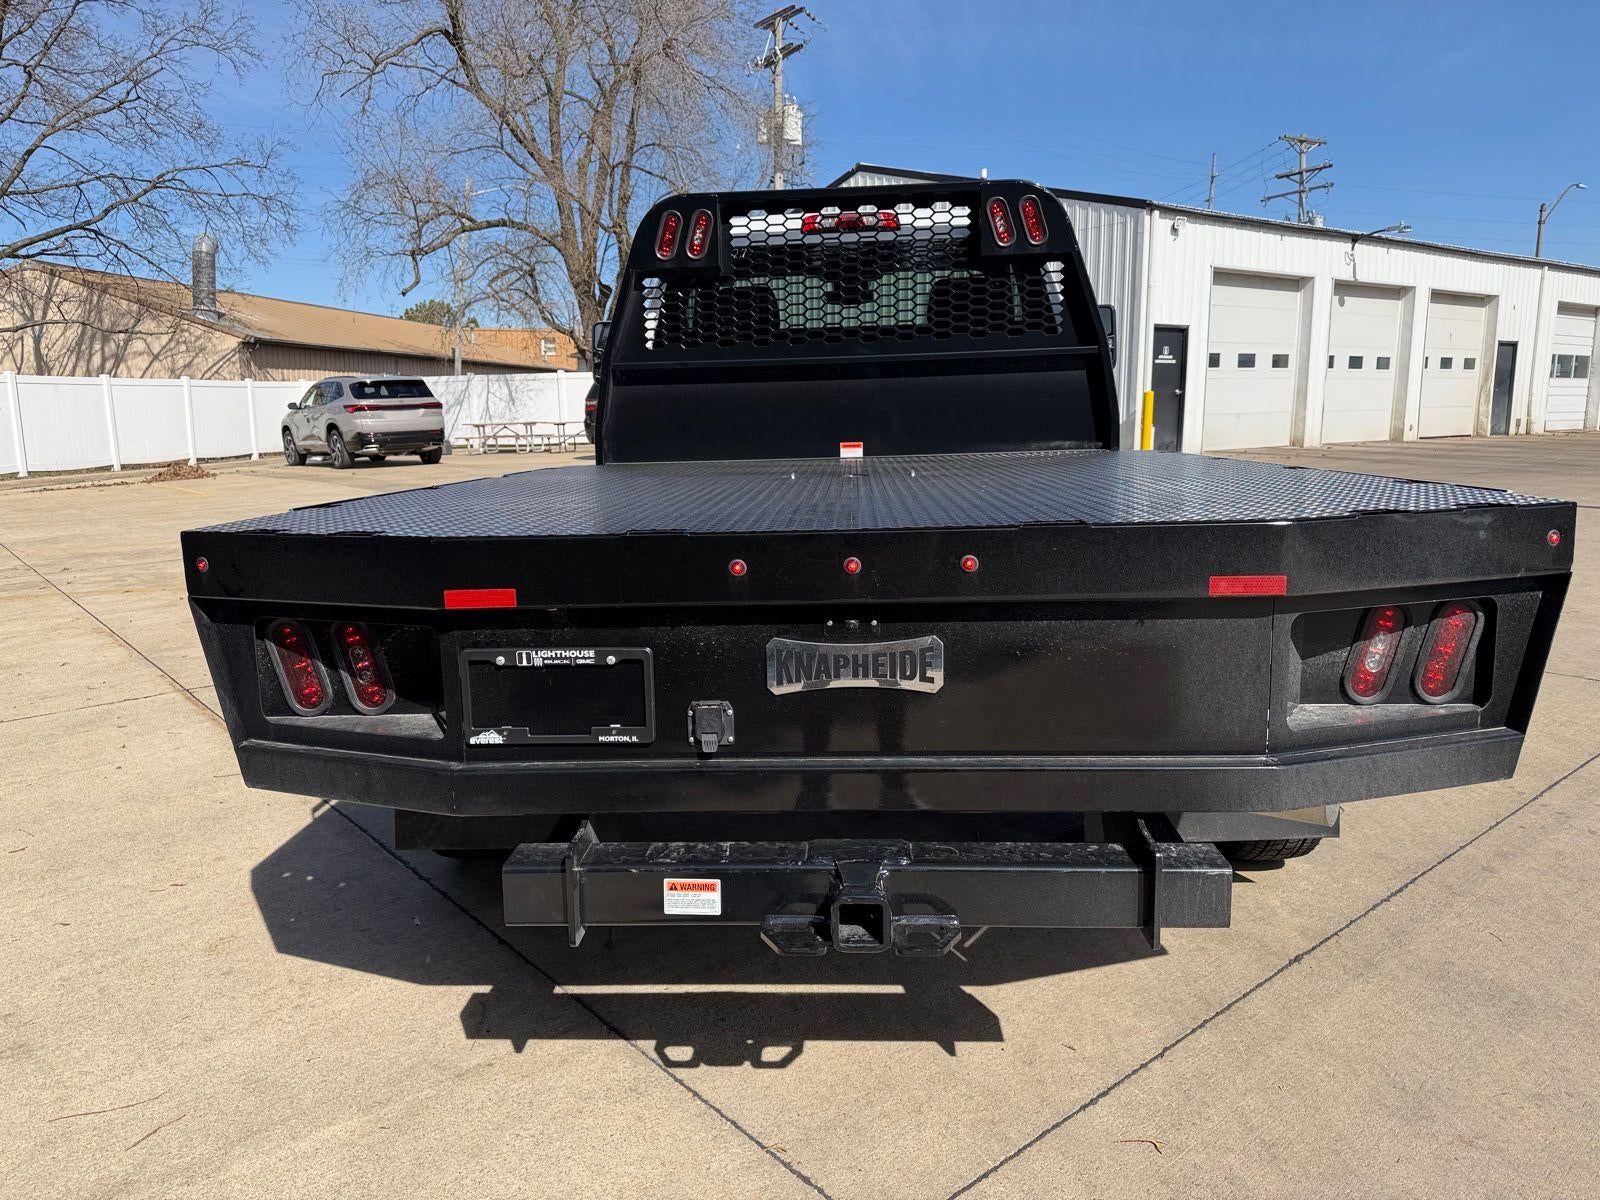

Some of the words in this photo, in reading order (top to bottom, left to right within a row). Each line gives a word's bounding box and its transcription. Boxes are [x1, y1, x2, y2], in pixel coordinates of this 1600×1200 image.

[532, 650, 596, 658] LIGHTHOUSE
[774, 645, 936, 686] KNAPHEIDE
[598, 735, 632, 743] MORTON,
[680, 883, 715, 891] WARNING
